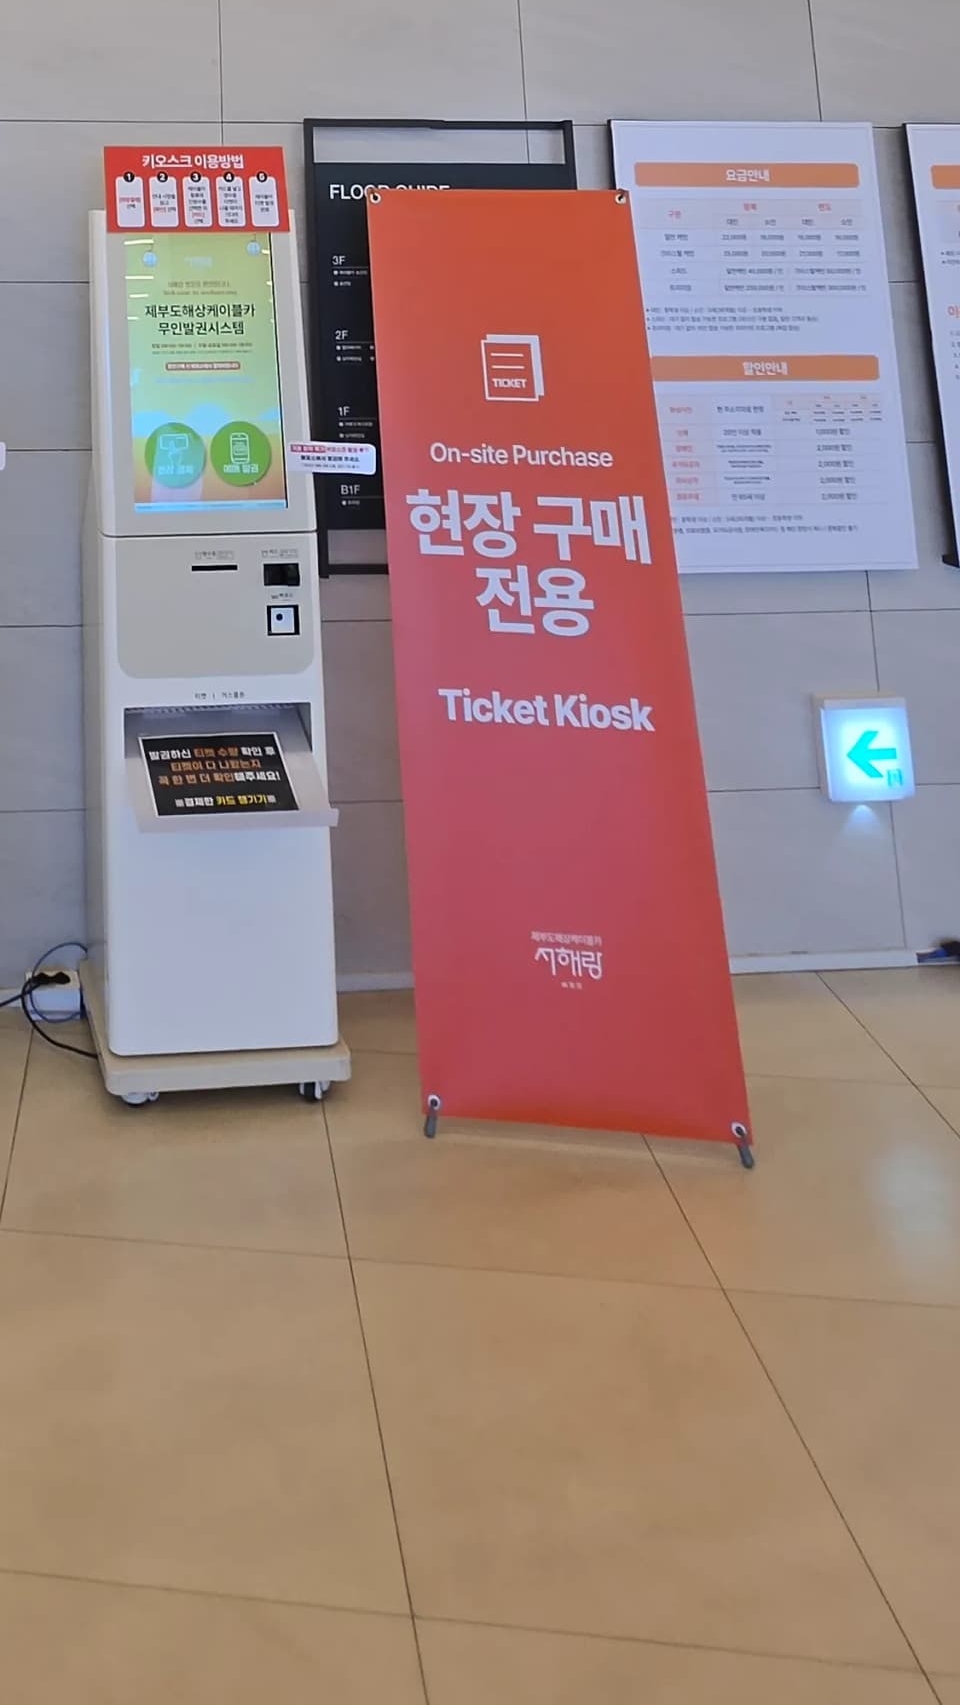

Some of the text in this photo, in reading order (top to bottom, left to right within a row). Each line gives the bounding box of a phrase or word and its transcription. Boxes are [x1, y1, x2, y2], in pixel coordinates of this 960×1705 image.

[142, 154, 244, 169] 키오스크 이용방법
[726, 168, 770, 182] 요금안내
[332, 255, 346, 266] 3F
[145, 303, 256, 318] 제부도해상케이블카
[158, 321, 244, 336] 무인발권시스템
[335, 330, 349, 341] 2F
[492, 377, 528, 390] TICKET
[338, 406, 351, 416] 1F
[430, 442, 614, 467] On-site Purchase
[340, 485, 361, 496] B1F
[406, 488, 653, 565] 현장 구매
[475, 565, 595, 637] 전용
[438, 687, 656, 732] Ticket Kiosk
[194, 748, 215, 758] 티켓
[240, 746, 262, 757] 확인
[264, 746, 276, 755] 후
[205, 761, 216, 770] 다
[200, 774, 211, 783] 더
[215, 796, 237, 805] 카드
